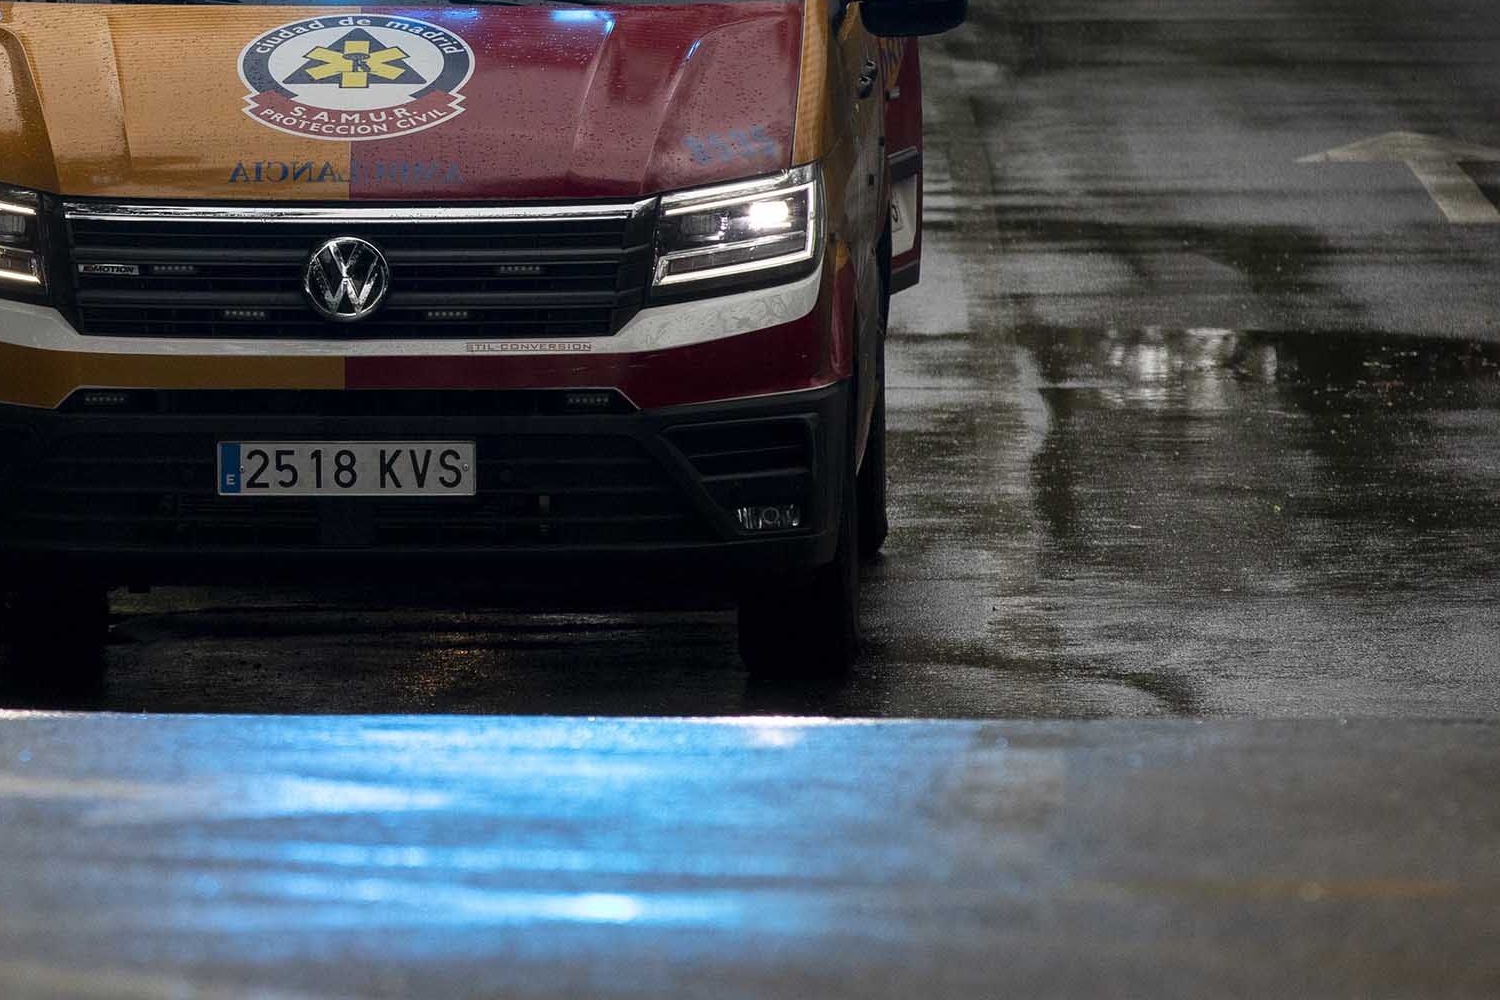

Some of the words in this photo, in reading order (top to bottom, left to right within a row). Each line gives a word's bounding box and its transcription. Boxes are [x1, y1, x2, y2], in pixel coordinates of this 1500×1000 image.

[256, 20, 325, 53] ciudad
[338, 16, 372, 27] de
[385, 20, 465, 54] madrid
[260, 108, 388, 135] PROTECCION
[396, 108, 448, 129] CIVIL
[290, 106, 419, 124] S.A.M.U.R.
[226, 474, 236, 485] E
[246, 449, 358, 489] 2518
[379, 449, 462, 489] KVS
